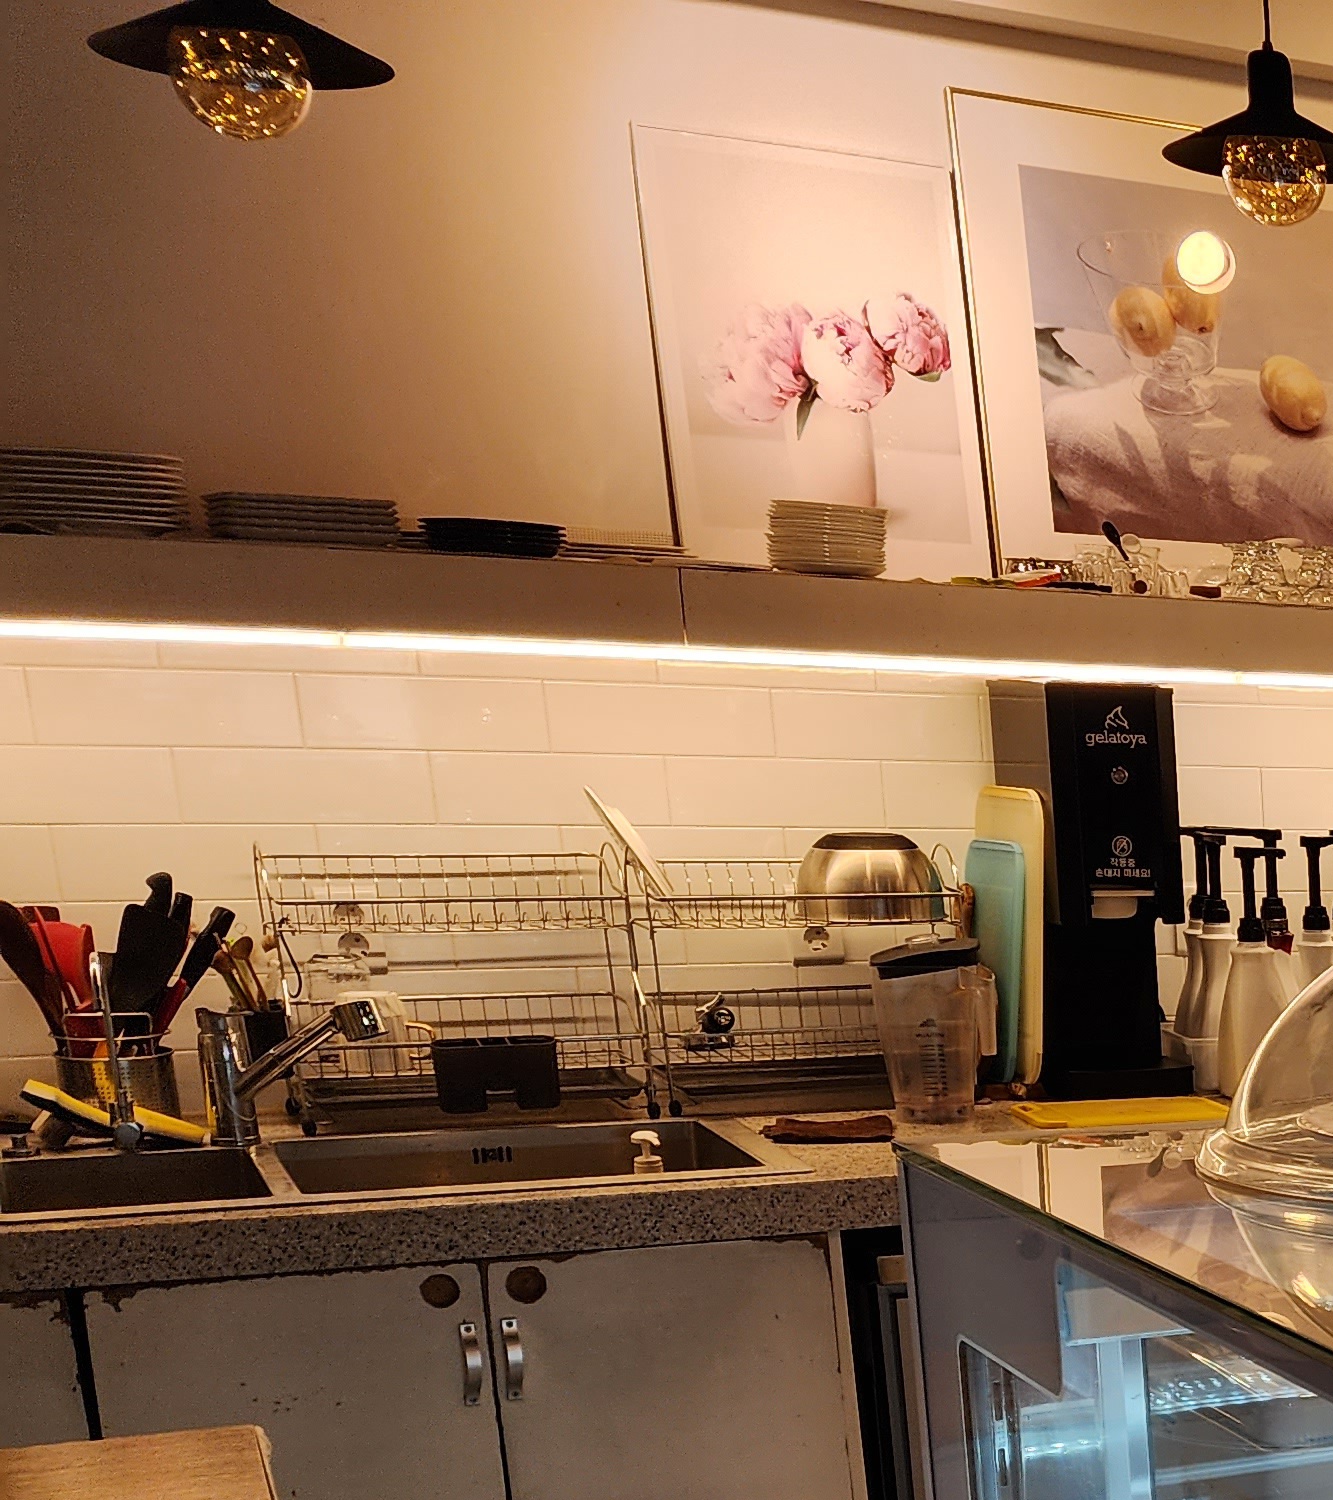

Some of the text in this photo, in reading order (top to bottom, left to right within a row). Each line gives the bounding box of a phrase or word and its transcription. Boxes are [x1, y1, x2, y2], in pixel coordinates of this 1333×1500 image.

[1085, 730, 1148, 748] gelatoya
[1110, 857, 1136, 868] 작동중
[1095, 868, 1121, 878] 손대지
